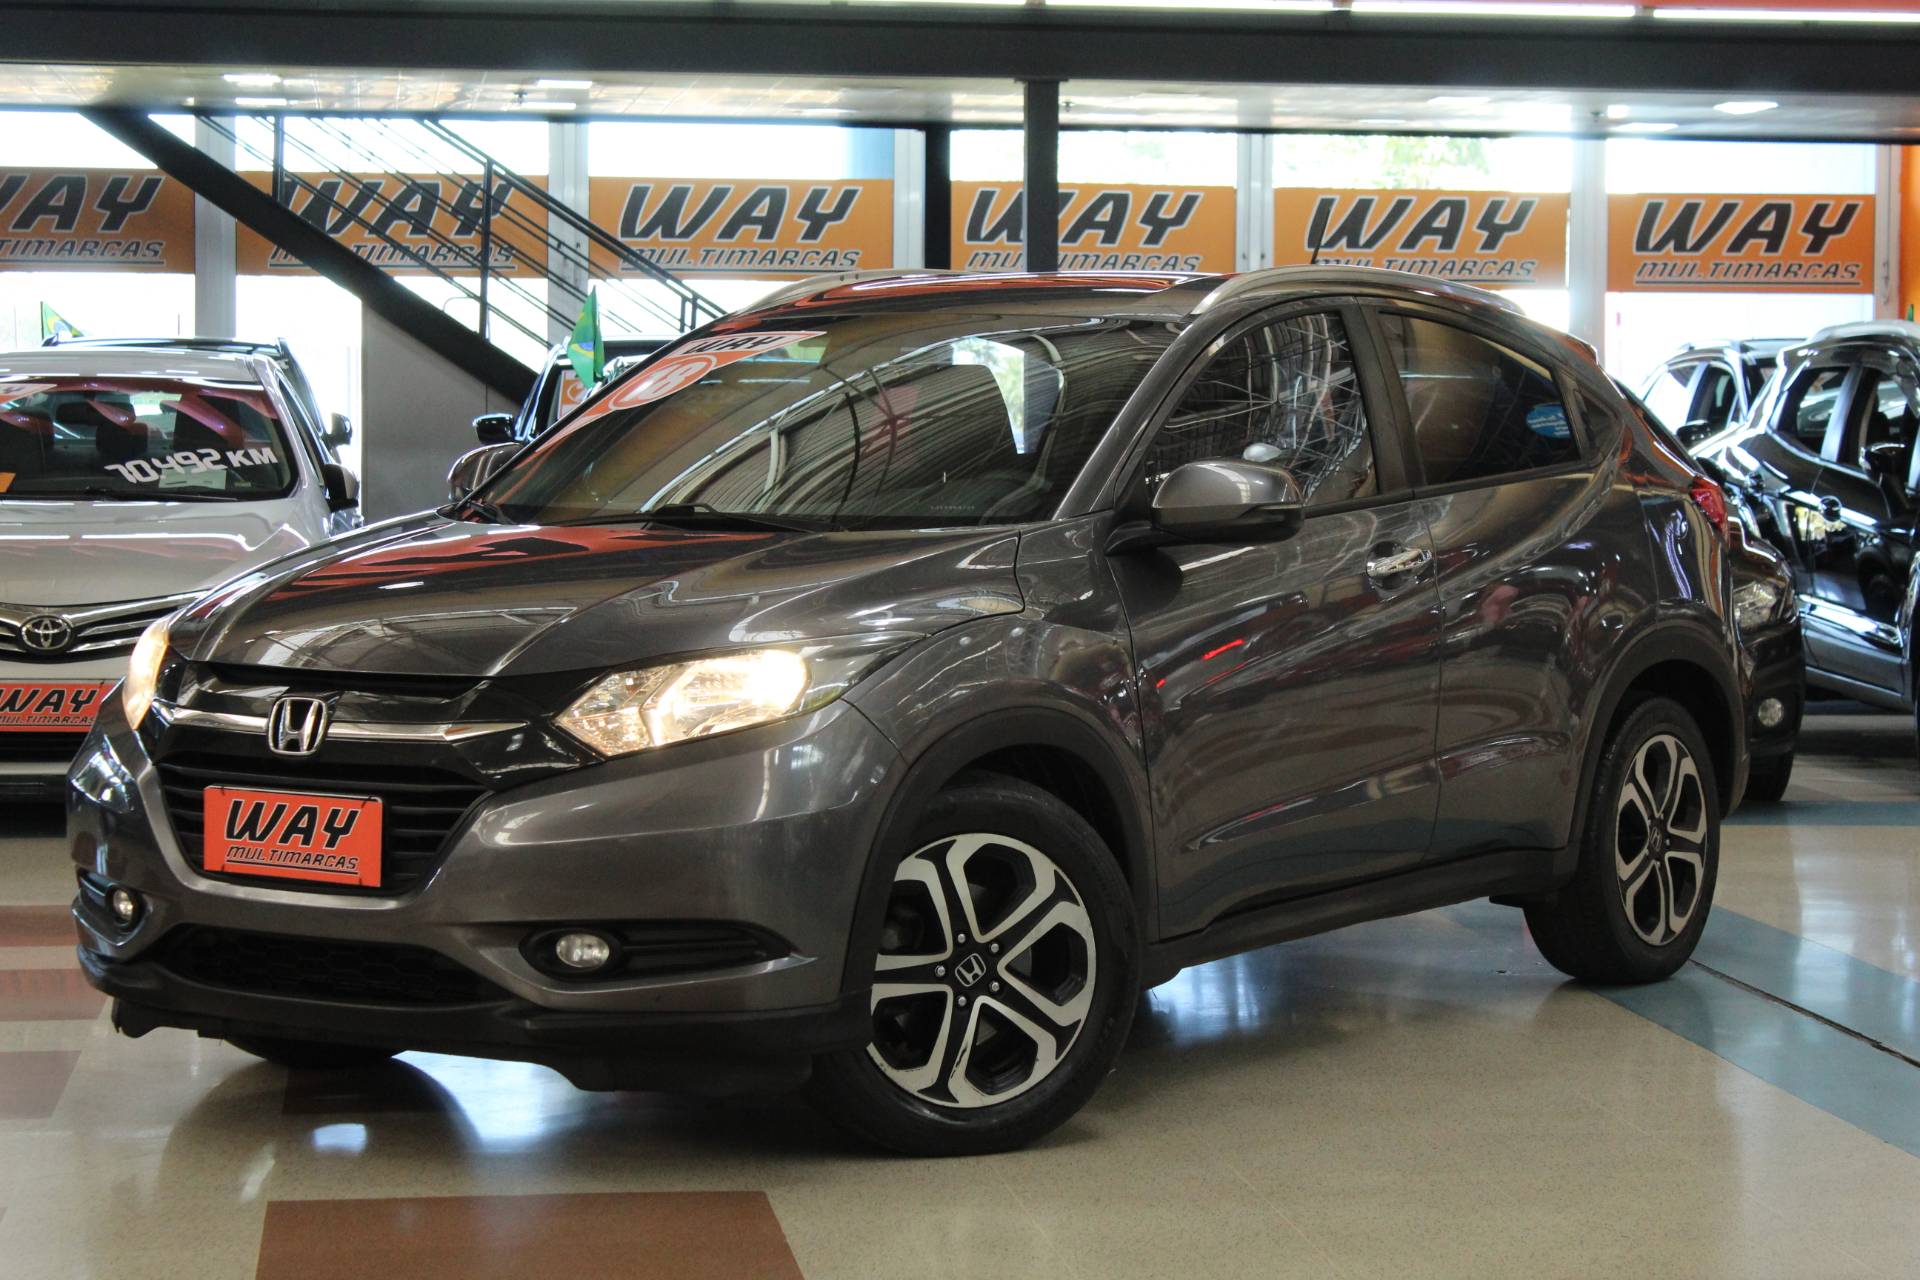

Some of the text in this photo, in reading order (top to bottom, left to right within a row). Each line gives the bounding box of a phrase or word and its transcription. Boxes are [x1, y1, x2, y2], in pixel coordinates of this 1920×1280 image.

[0, 174, 166, 233] AY
[284, 179, 514, 238] WAY
[619, 184, 863, 242] WAY
[964, 188, 1204, 247] WAY
[1305, 195, 1539, 253] WAY
[1633, 200, 1863, 256] WAY
[967, 252, 1201, 271] MUIMARCAS
[1635, 261, 1862, 279] MULTIMARCAS
[226, 447, 278, 468] KM
[0, 687, 99, 713] WAY
[225, 799, 361, 850] WAY
[226, 846, 359, 870] MULTIMARCAS
